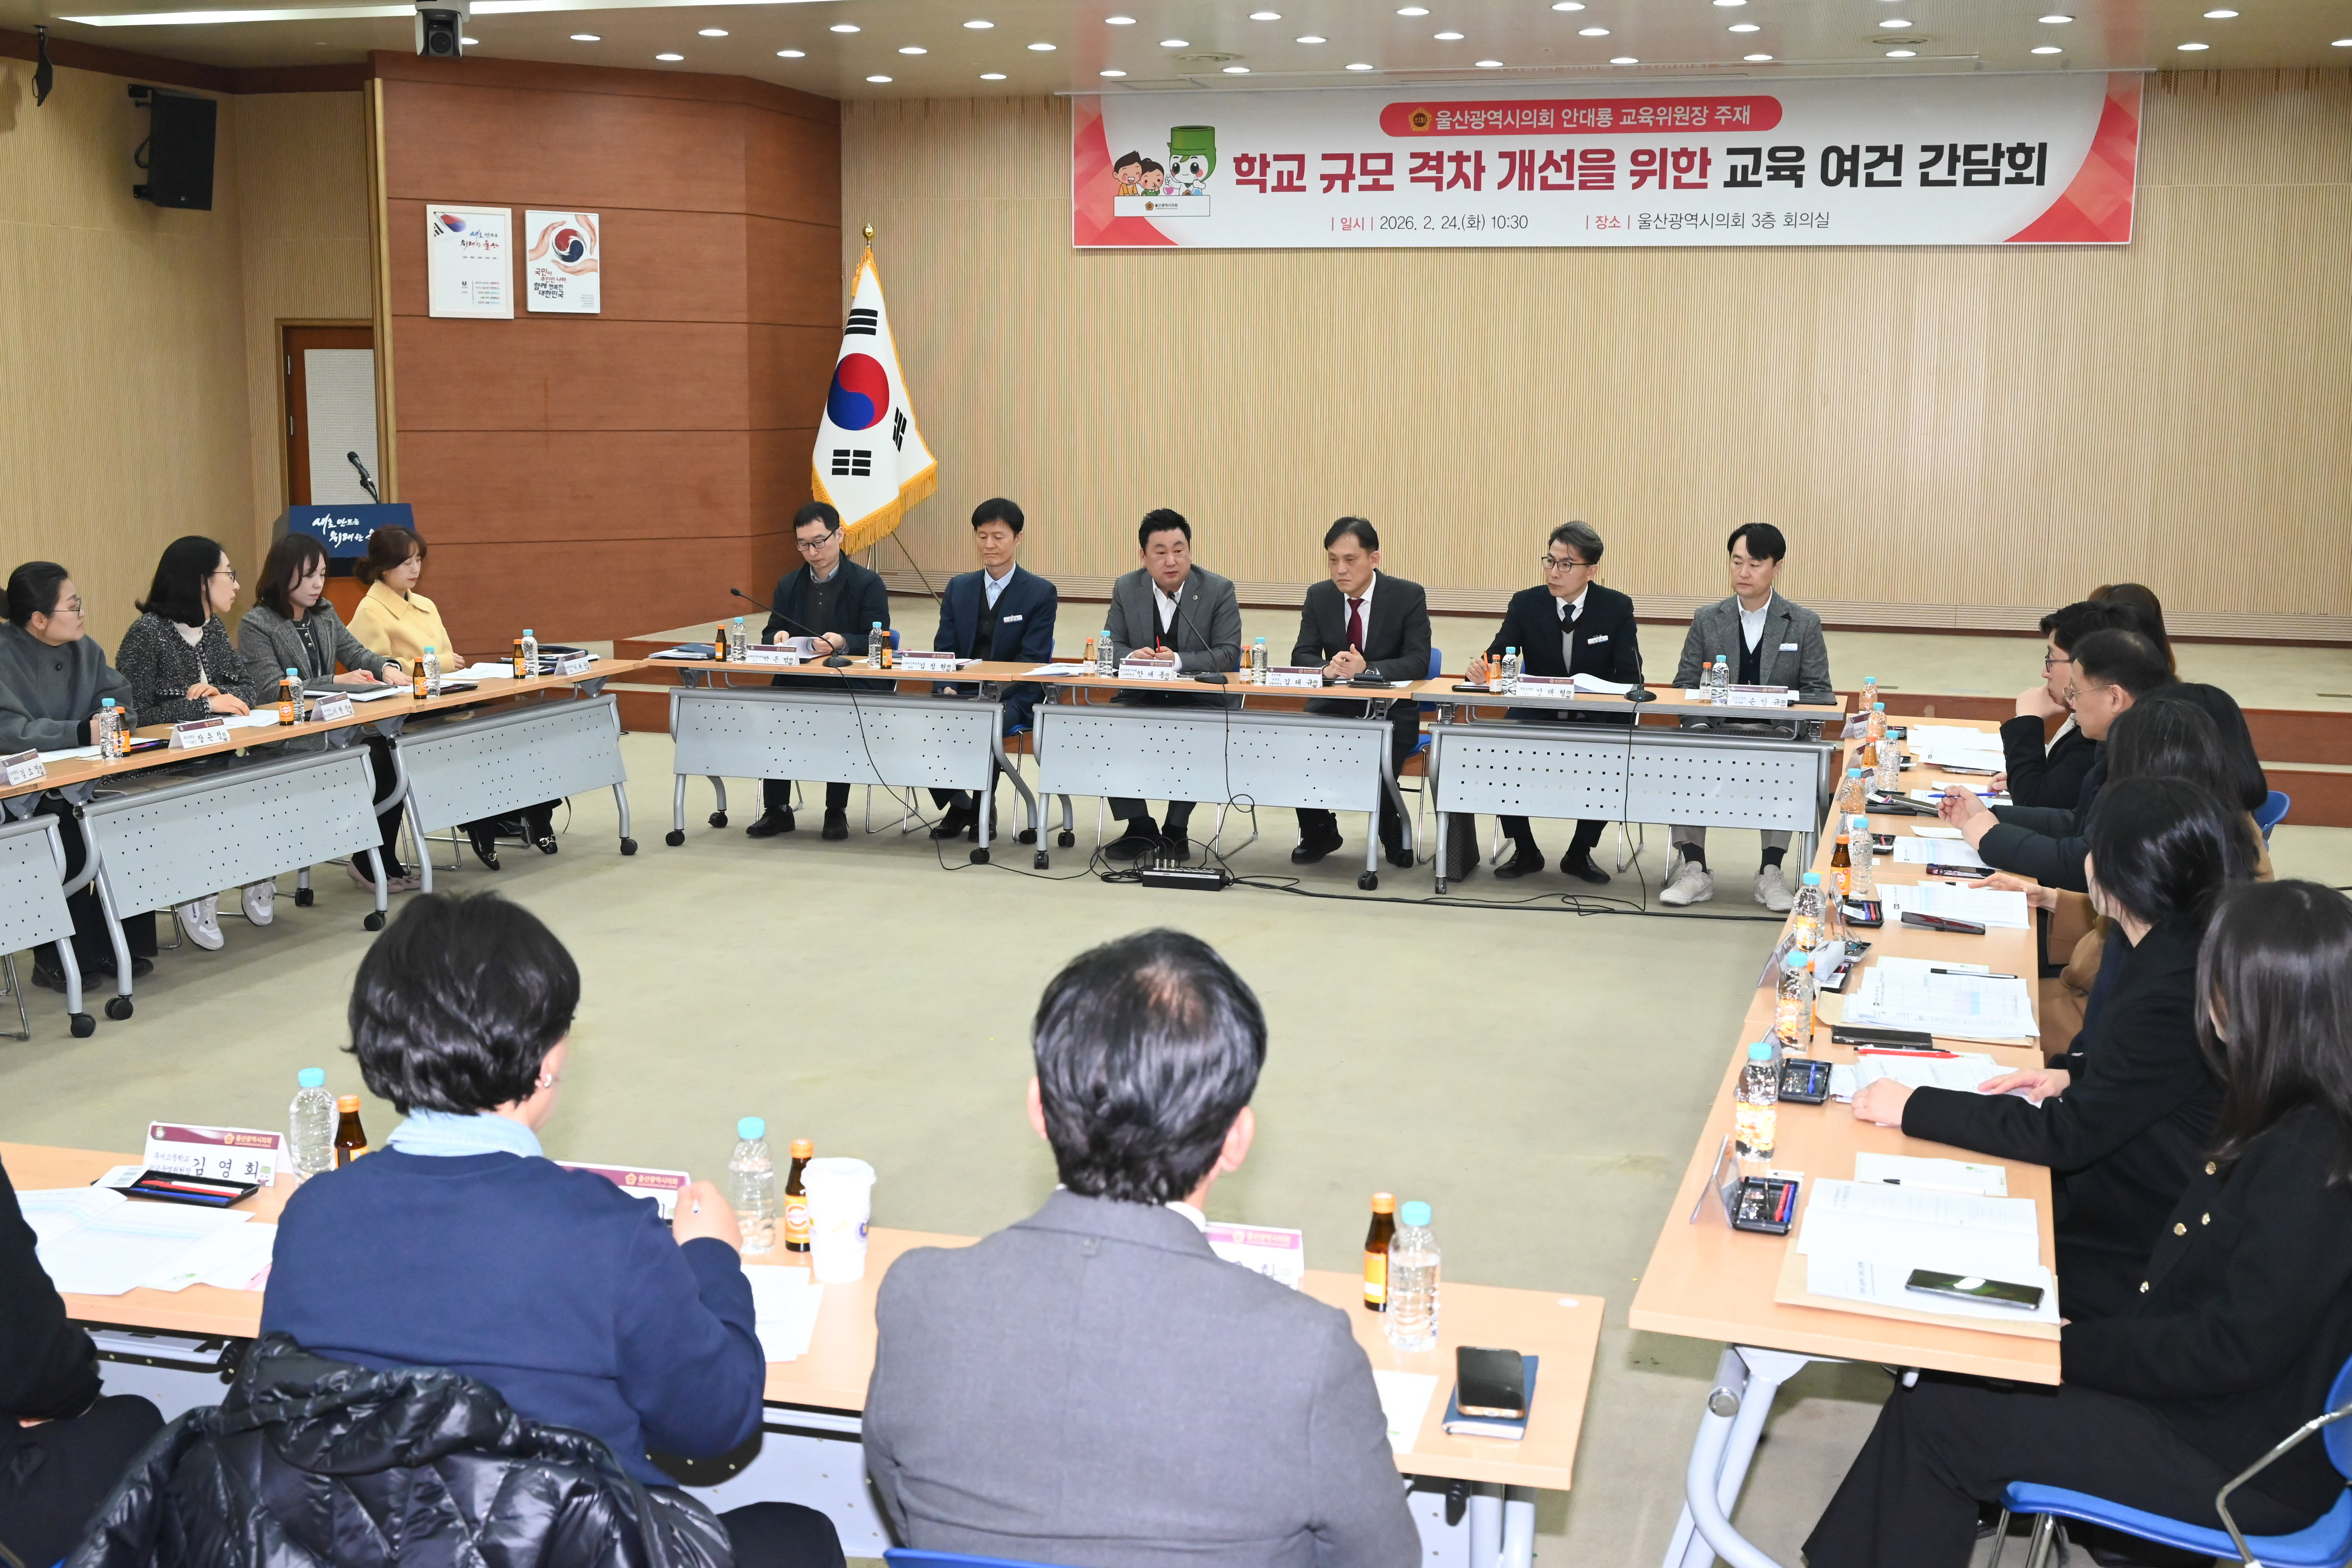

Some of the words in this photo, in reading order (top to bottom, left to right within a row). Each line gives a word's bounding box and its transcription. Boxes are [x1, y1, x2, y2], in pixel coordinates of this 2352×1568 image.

[1436, 109, 1553, 129] 울산광역시의회
[1562, 108, 1613, 127] 안대룡
[1620, 106, 1709, 126] 교육위원장
[1714, 105, 1750, 125] 주재
[1233, 153, 1306, 193] 학교
[1320, 153, 1394, 193] 규모
[1409, 150, 1486, 191] 격차
[1498, 149, 1615, 191] 개선을
[1630, 147, 1711, 190] 위한
[1723, 146, 1805, 188] 교육
[1821, 144, 1903, 187] 여건
[1919, 142, 2047, 187] 간담회
[1341, 217, 1364, 230] 일시
[1380, 216, 1416, 230] 2026.
[1424, 216, 1434, 230] 2.
[1441, 214, 1485, 231] 24.(화)
[1492, 215, 1528, 228] 10:30
[1596, 215, 1621, 229] 장소
[1638, 213, 1744, 229] 울산광역시의회
[1752, 212, 1776, 229] 3층
[1783, 212, 1829, 228] 회의실
[535, 268, 552, 276] 국민이
[534, 282, 547, 290] 함께
[538, 290, 564, 299] 대한민국
[312, 513, 337, 535] 새로
[337, 518, 360, 527] 만드는
[328, 530, 364, 548] 위대한
[235, 1135, 272, 1145] 울산광역시의회
